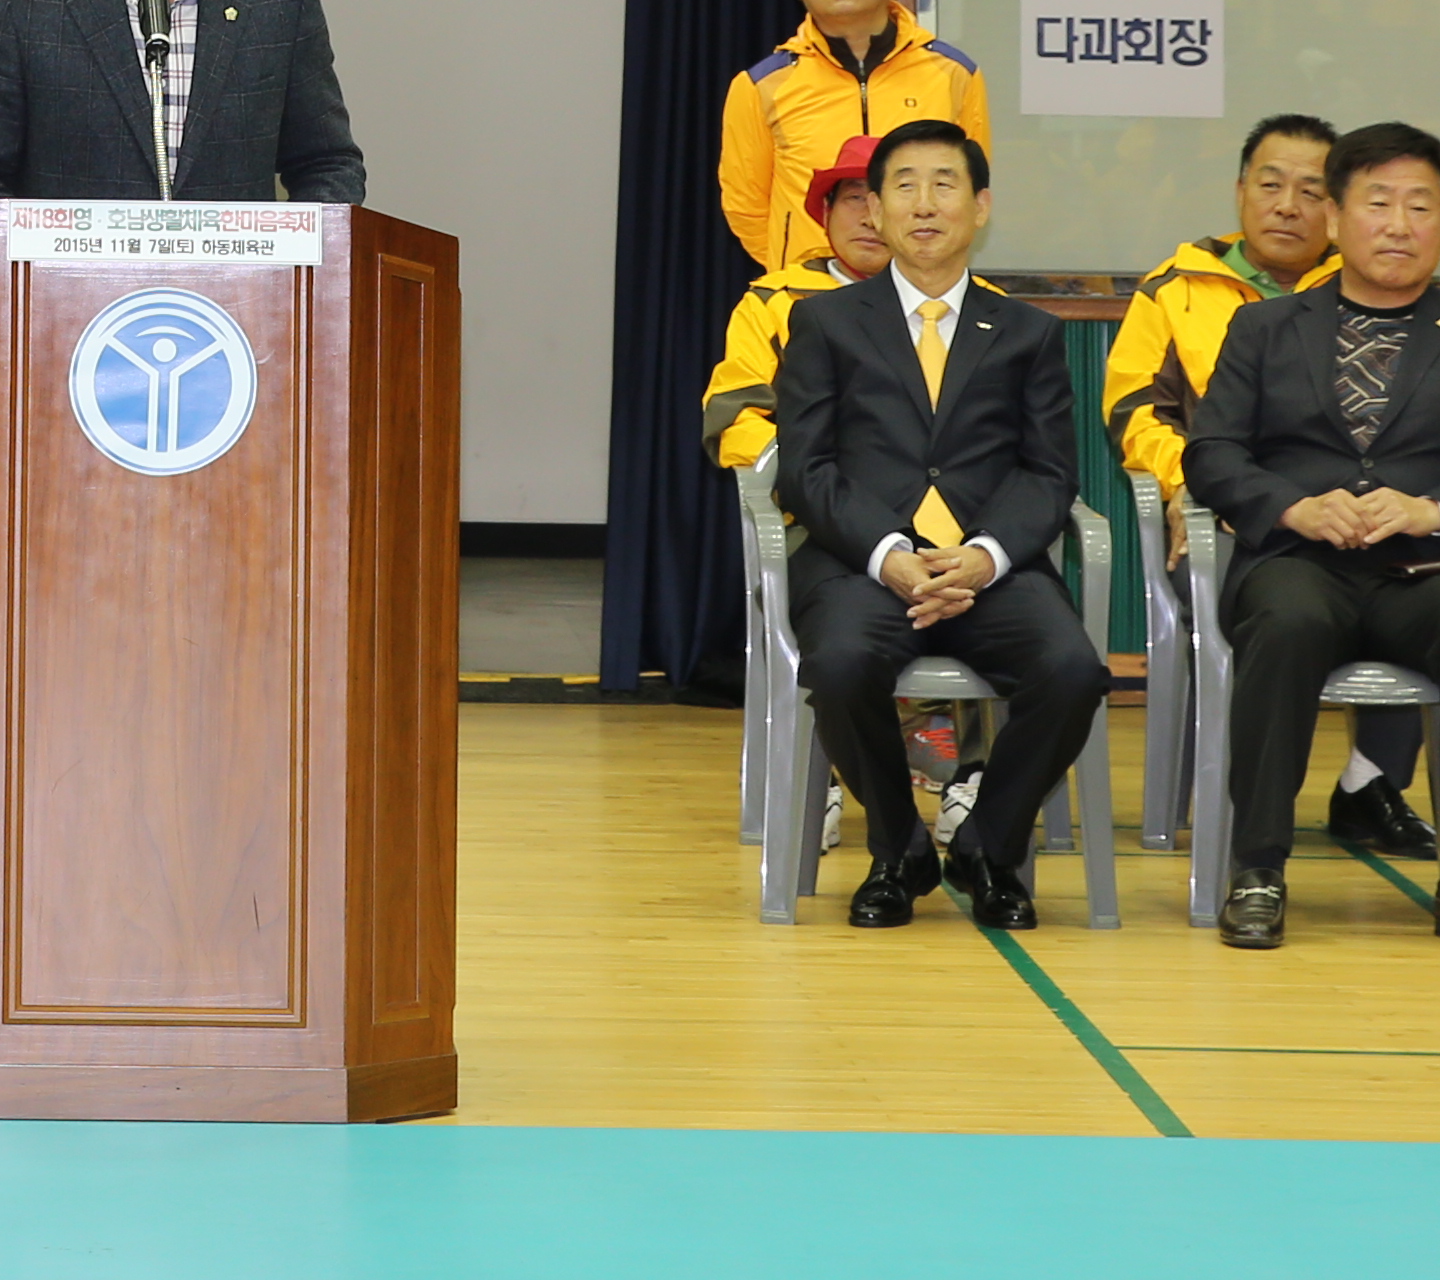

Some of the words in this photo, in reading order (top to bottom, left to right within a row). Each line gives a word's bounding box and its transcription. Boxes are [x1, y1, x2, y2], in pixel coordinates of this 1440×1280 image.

[1036, 16, 1213, 67] 다과회장
[54, 238, 102, 254] 2015년
[111, 238, 141, 254] 11월
[148, 238, 194, 255] 7일(토)
[202, 239, 275, 256] 하동체육관
